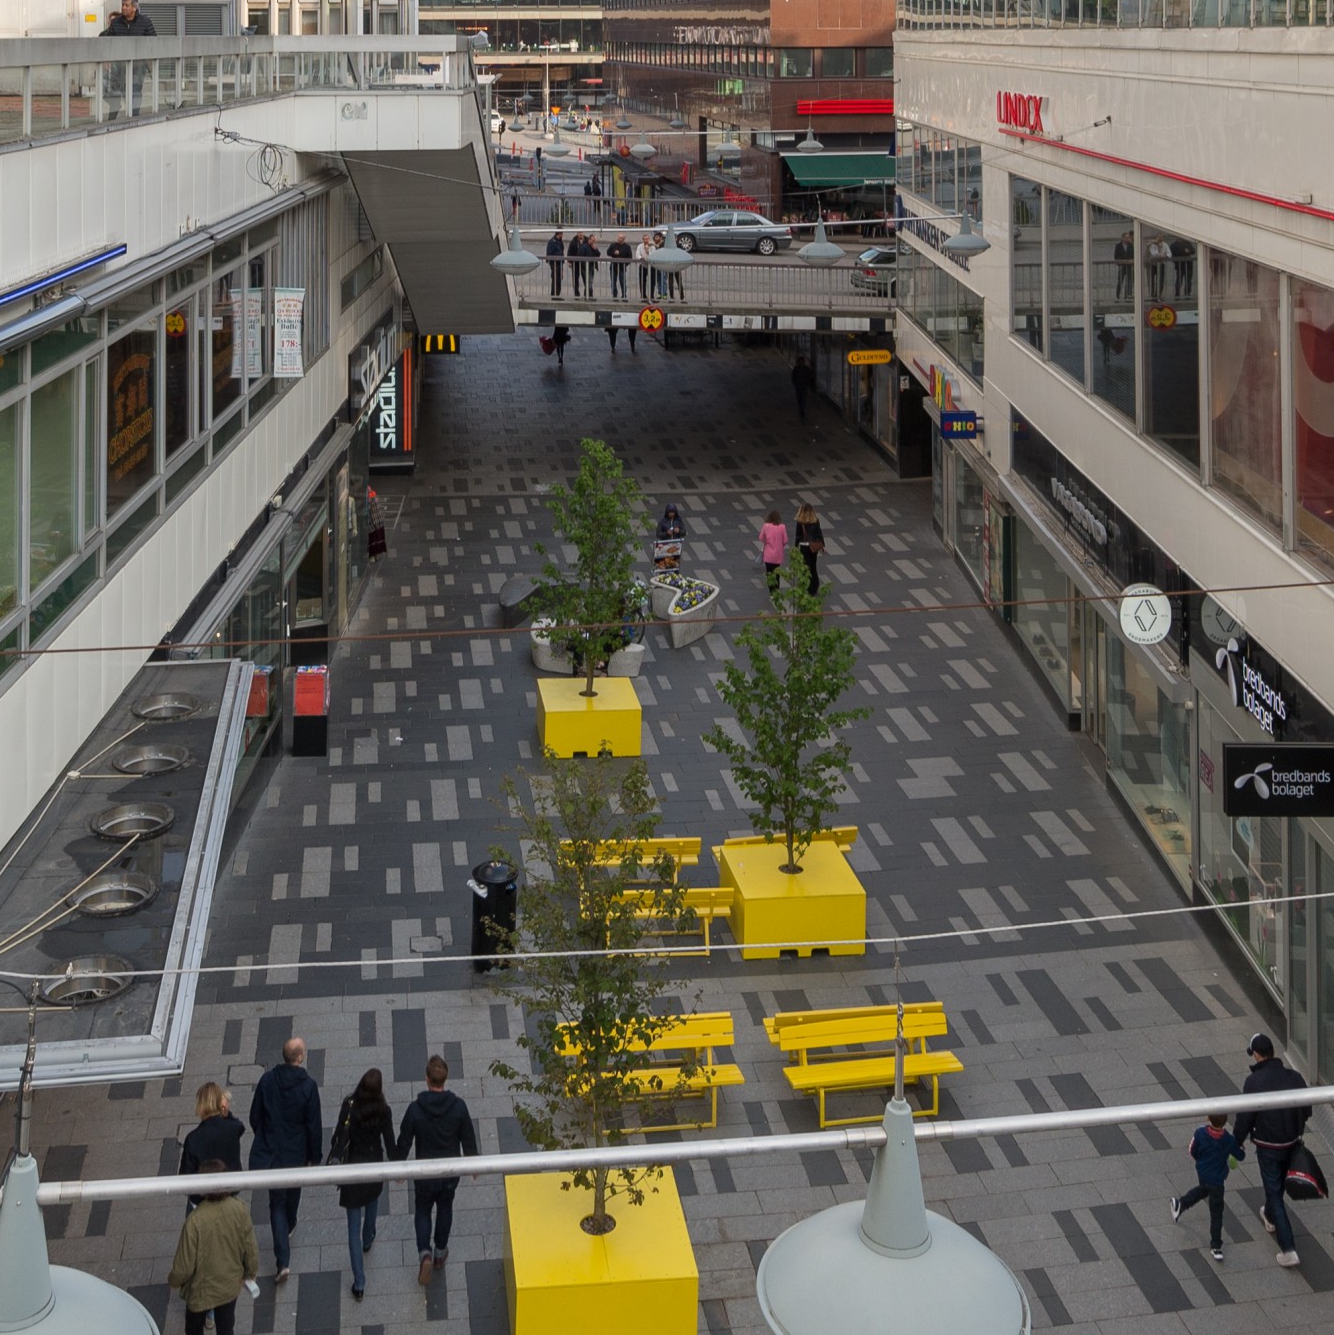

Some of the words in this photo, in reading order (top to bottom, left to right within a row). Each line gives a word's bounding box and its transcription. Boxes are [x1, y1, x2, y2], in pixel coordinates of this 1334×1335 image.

[997, 90, 1043, 133] LINDEX
[375, 366, 395, 449] stadiu
[1128, 632, 1164, 642] SHOEMAKERS
[1243, 656, 1286, 721] bredbands
[1243, 682, 1274, 735] bolaget
[1272, 769, 1331, 783] bredbands
[1272, 783, 1315, 799] bolaget
